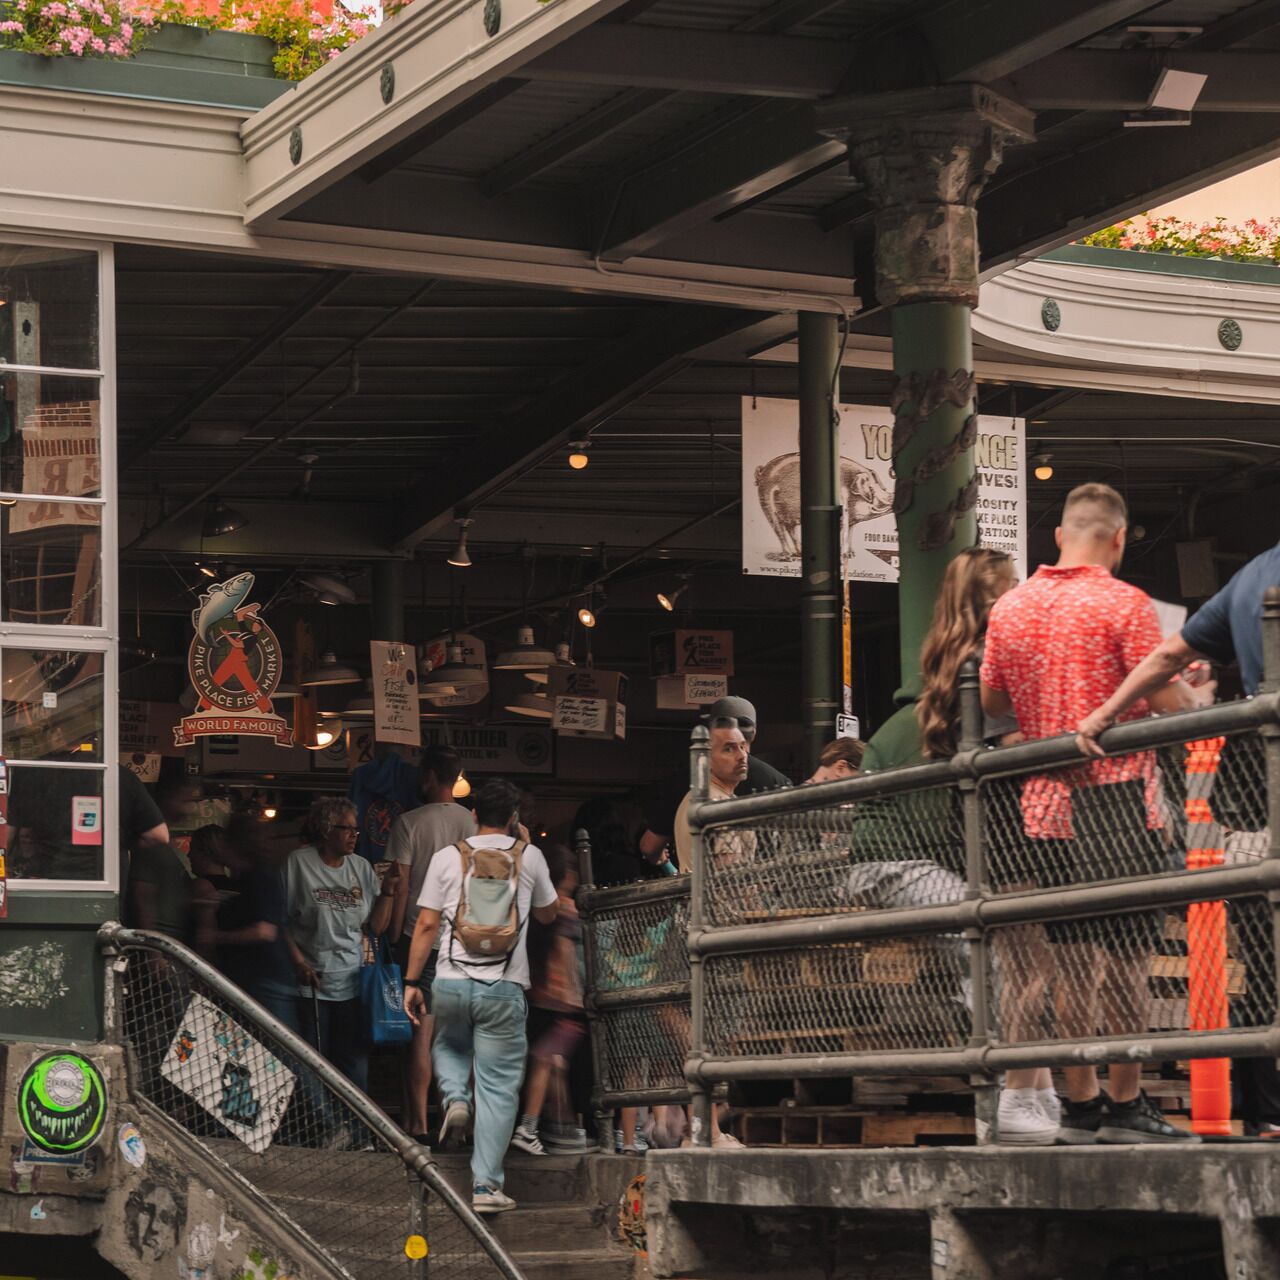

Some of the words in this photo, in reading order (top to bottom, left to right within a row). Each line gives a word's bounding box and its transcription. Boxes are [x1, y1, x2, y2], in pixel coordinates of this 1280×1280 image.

[991, 514, 1018, 527] PLACE
[193, 645, 206, 677] PIKE
[261, 637, 277, 691] MARKET
[199, 679, 233, 707] PLACE
[236, 690, 263, 707] FISH
[187, 720, 231, 732] WORLD
[233, 720, 283, 733] FAMOUS
